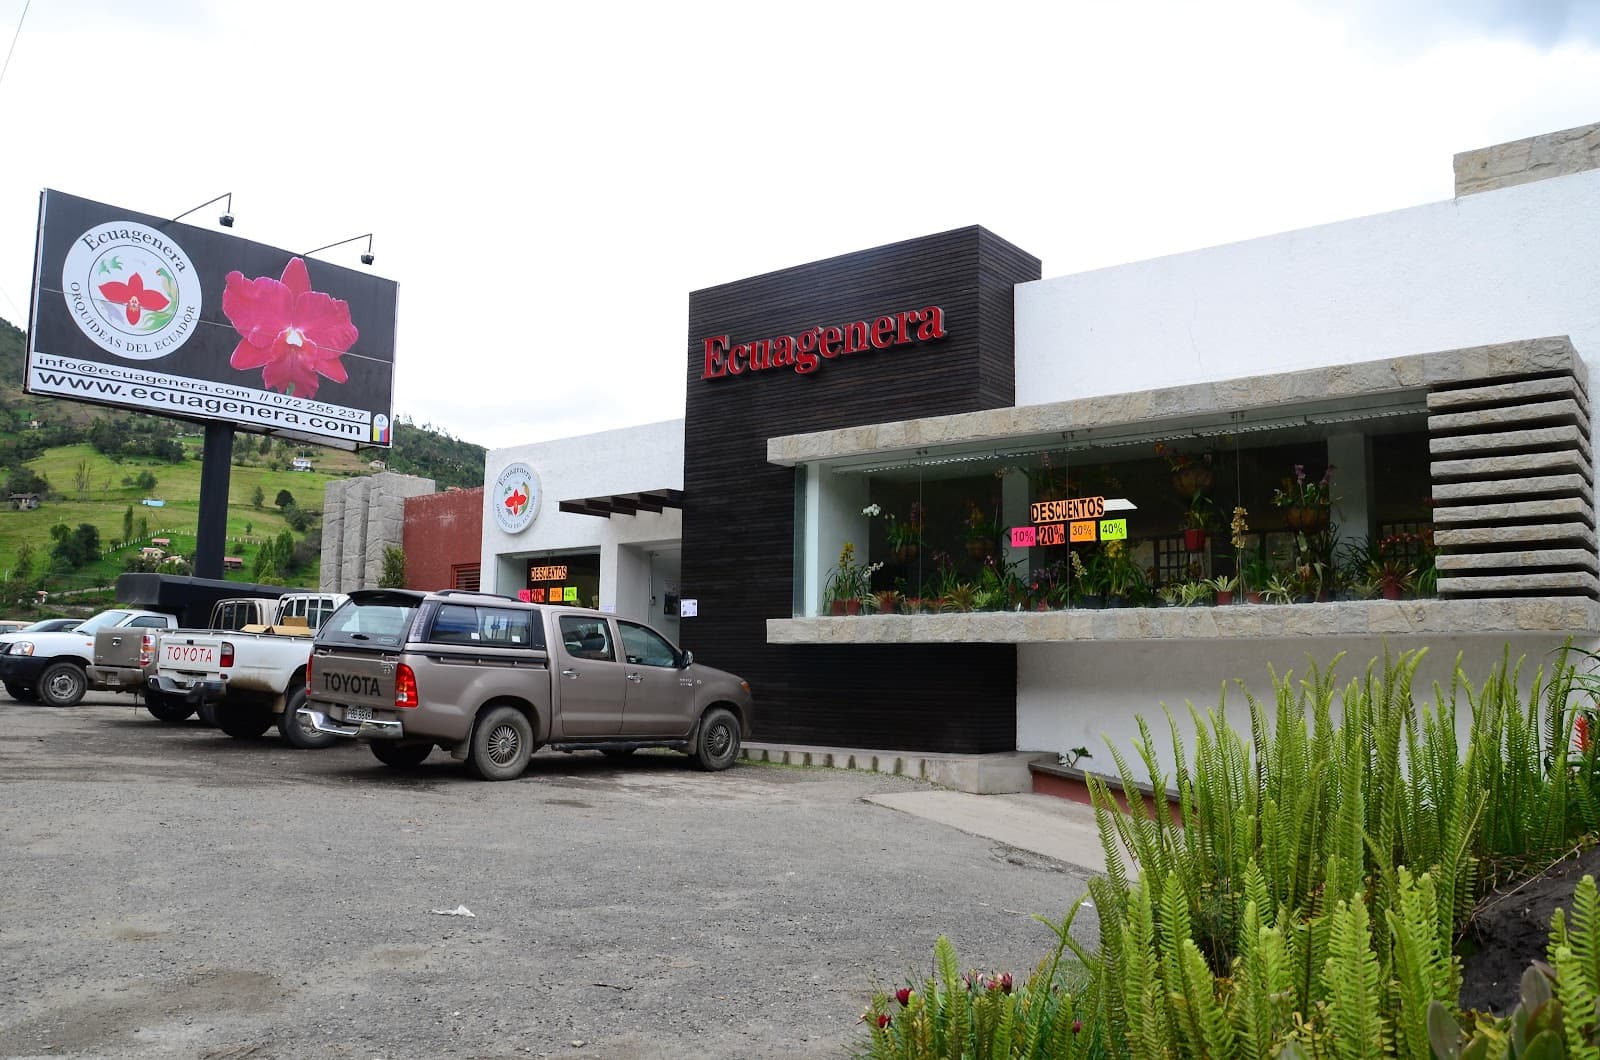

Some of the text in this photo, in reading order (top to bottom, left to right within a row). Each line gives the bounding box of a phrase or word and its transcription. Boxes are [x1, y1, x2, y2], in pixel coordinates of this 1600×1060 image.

[82, 228, 187, 272] Ecuagenera
[126, 342, 152, 353] DEL
[155, 305, 195, 351] ECUADOR
[700, 305, 947, 380] Ecuagenera
[38, 371, 361, 436] www.ecuagenera.com
[39, 356, 251, 399] info@ecuagenera.com
[273, 395, 301, 408] 072
[306, 402, 334, 415] 255
[338, 408, 366, 420] 237
[1031, 496, 1105, 522] DESCUENTOS
[1013, 522, 1123, 545] 10% 20% 30% 40%
[167, 646, 213, 663] TOYOTA
[323, 671, 381, 697] TOYOTA
